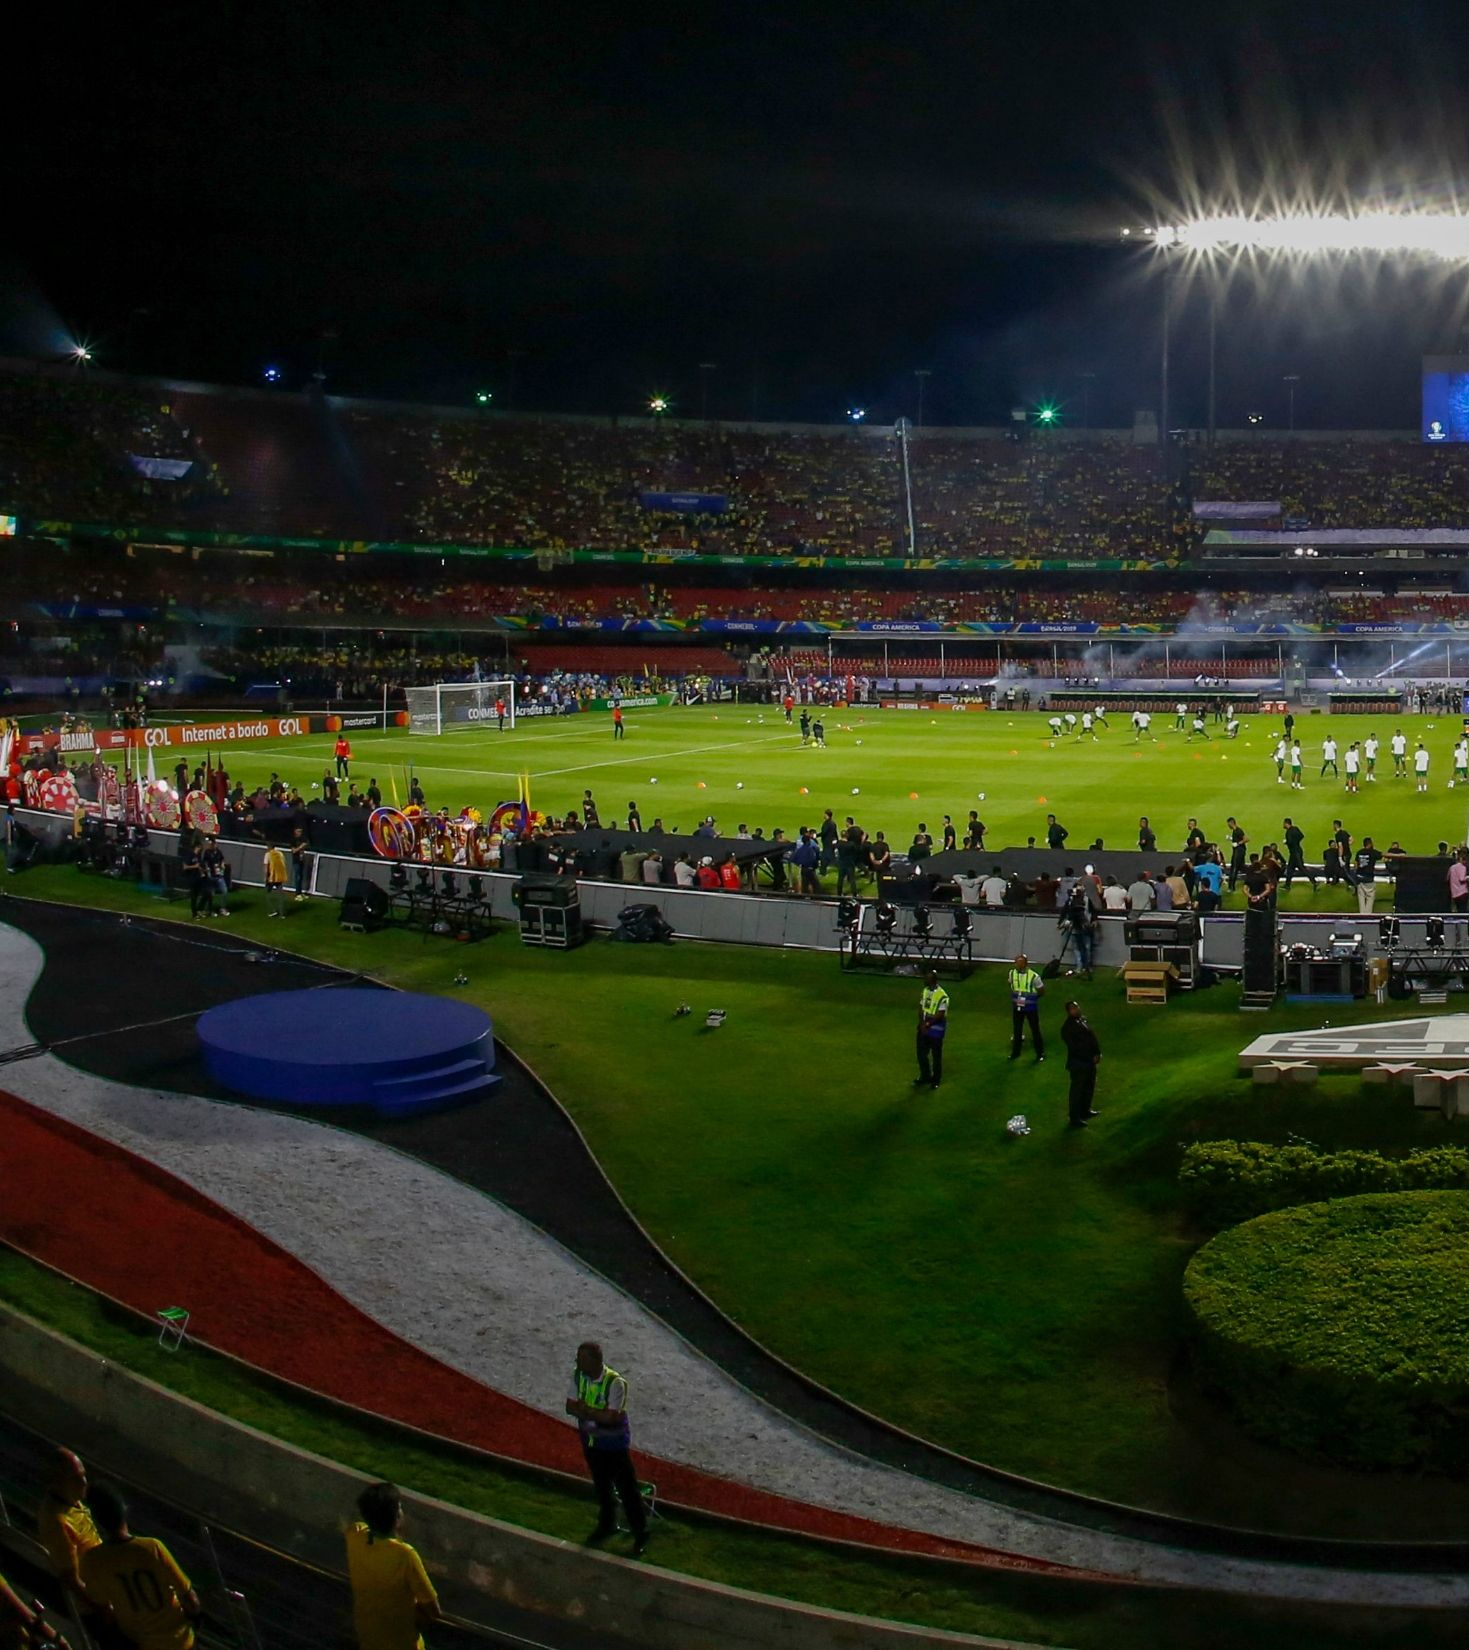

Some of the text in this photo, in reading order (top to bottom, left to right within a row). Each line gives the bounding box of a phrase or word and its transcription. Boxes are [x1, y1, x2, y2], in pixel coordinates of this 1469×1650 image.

[515, 704, 544, 716] Acredite
[279, 718, 303, 736] GOL
[343, 716, 377, 727] mastercard
[144, 728, 172, 746] GOL
[182, 721, 269, 743] Internet a bordo
[60, 732, 95, 752] BRAHMA
[116, 1568, 165, 1613] 10
